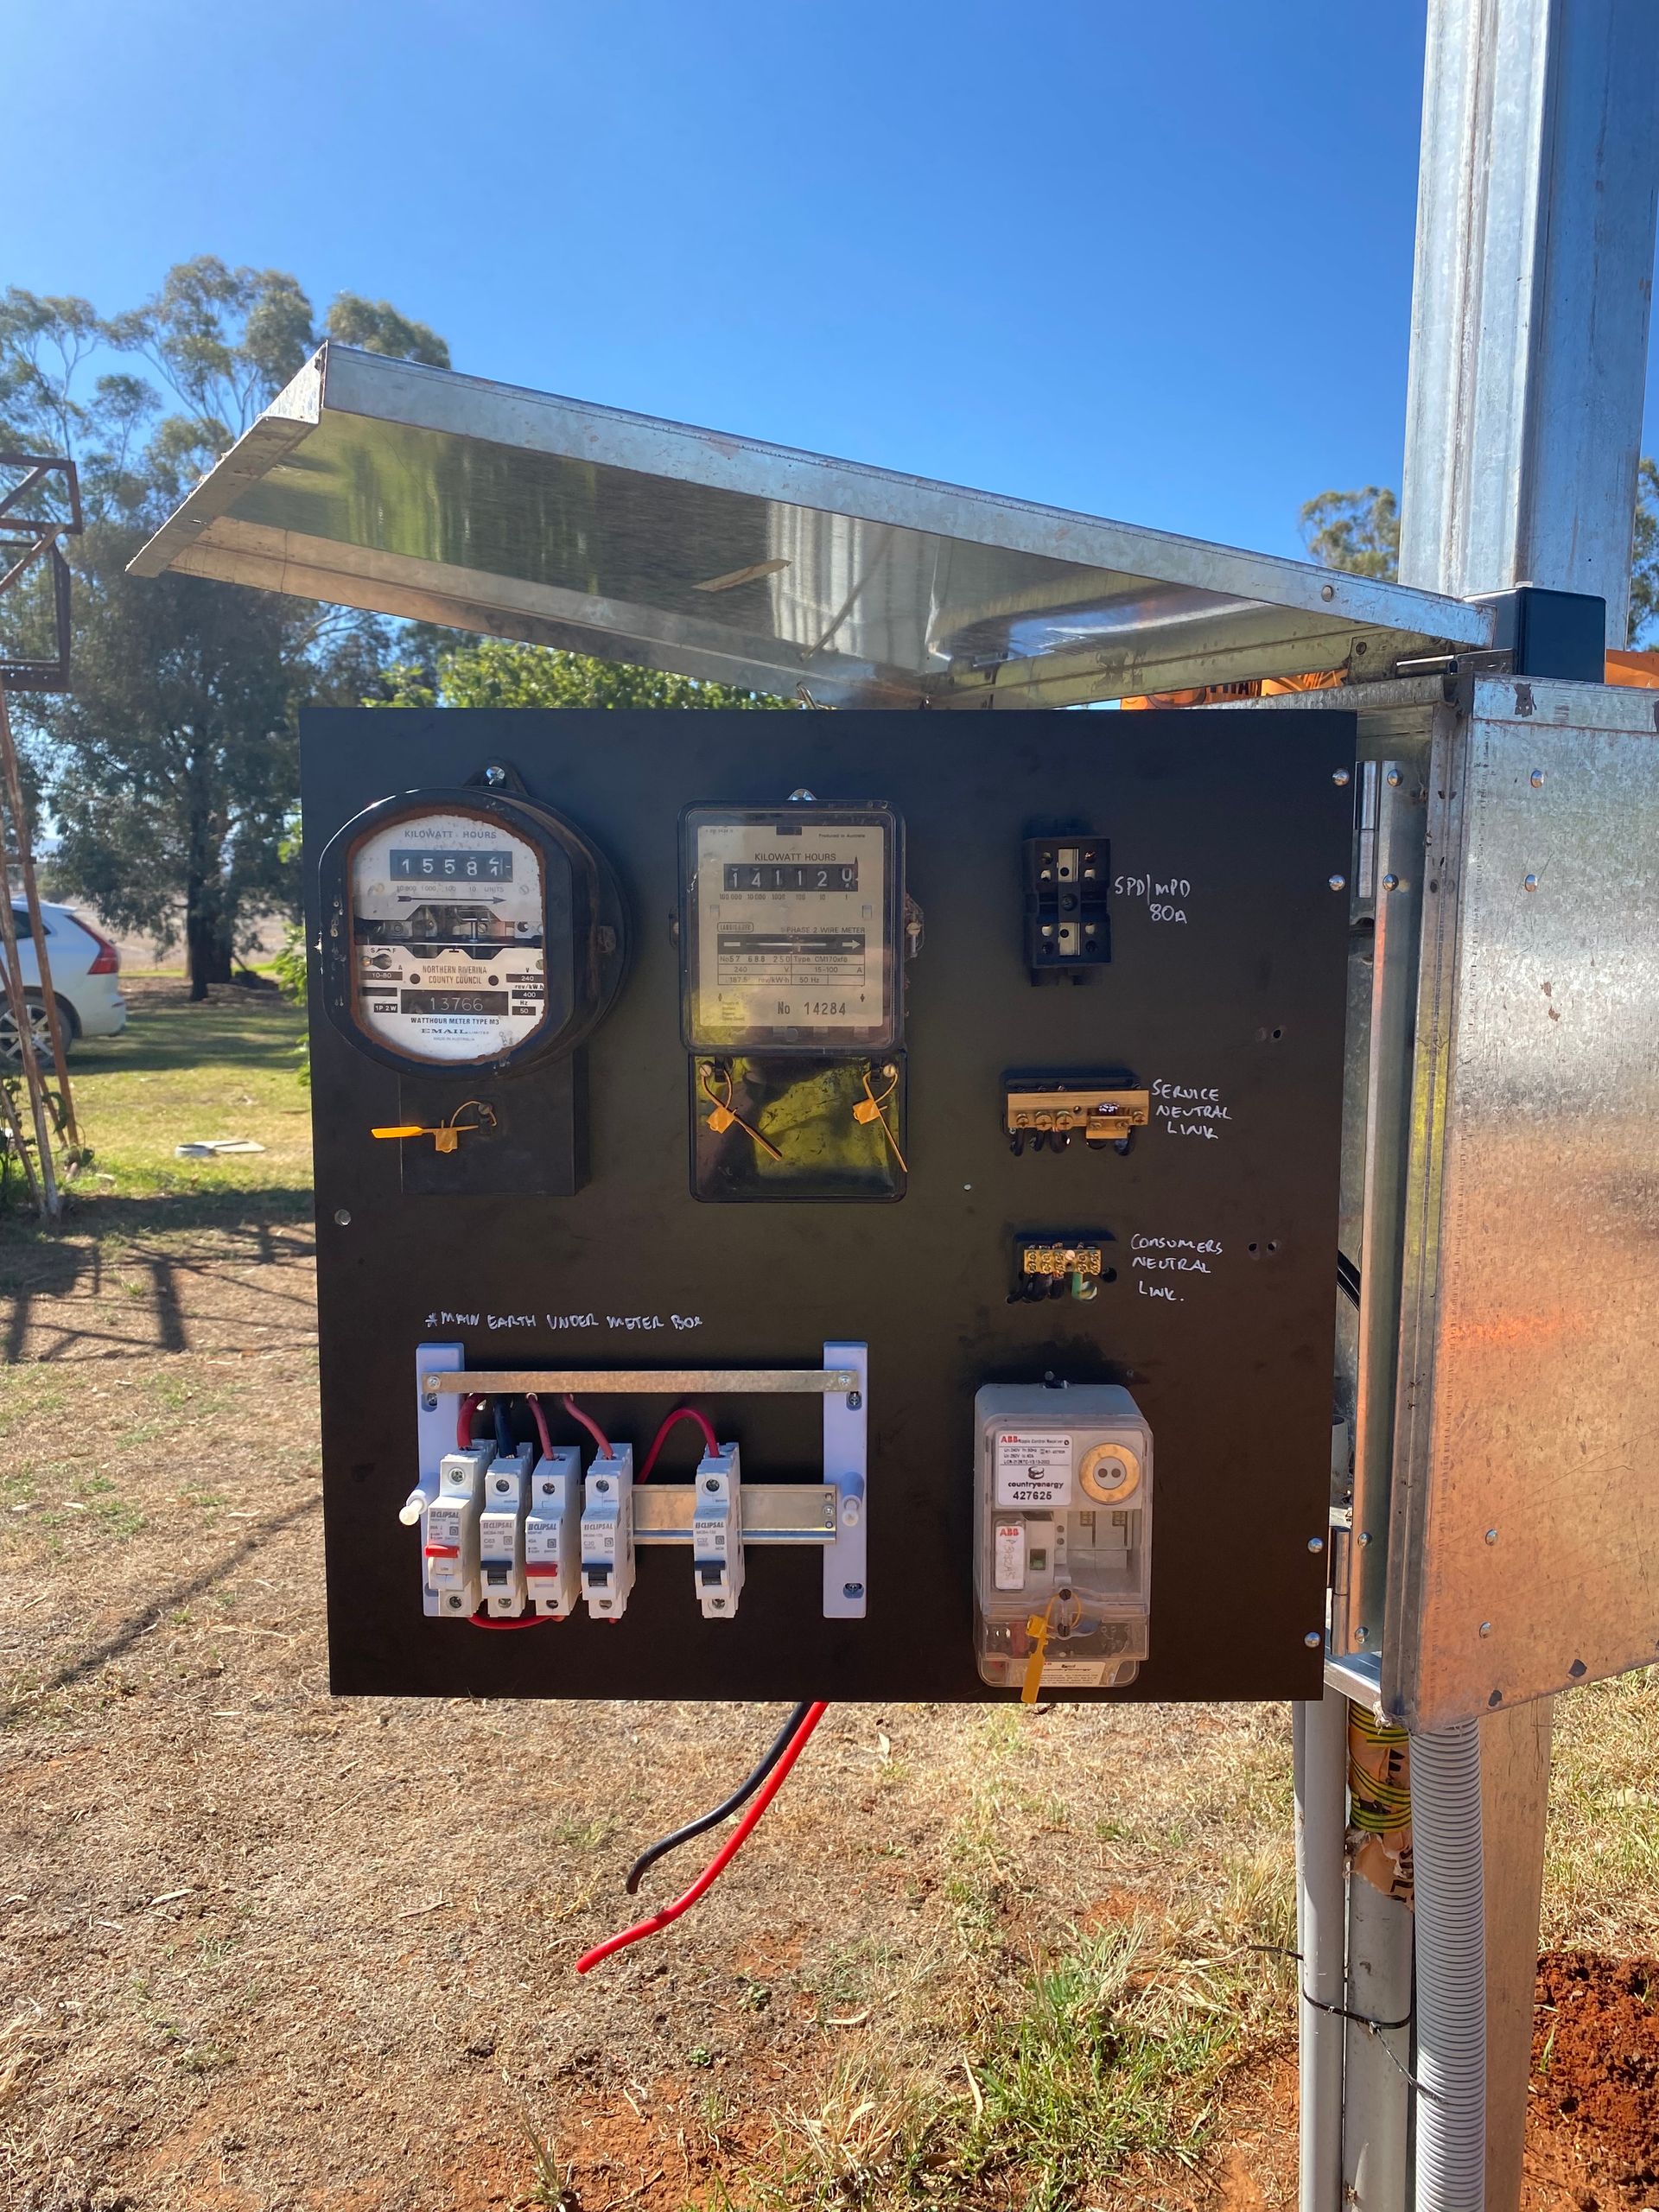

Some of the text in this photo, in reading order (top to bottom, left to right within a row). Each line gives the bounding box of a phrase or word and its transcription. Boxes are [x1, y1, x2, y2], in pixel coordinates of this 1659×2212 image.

[754, 853, 836, 861] KILOWATT HOURS
[1149, 903, 1187, 924] 80A
[430, 997, 483, 1011] 13766
[778, 1002, 847, 1015] No 14284
[1151, 1078, 1219, 1102] SERVICE
[1156, 1105, 1232, 1120] NEUTRAL
[1166, 1121, 1219, 1139] LINK
[1132, 1256, 1211, 1274] NEUTRAL
[486, 1314, 537, 1330] EARTH
[546, 1313, 600, 1330] UNDER
[607, 1313, 664, 1330] METER
[1000, 1528, 1020, 1536] ABB
